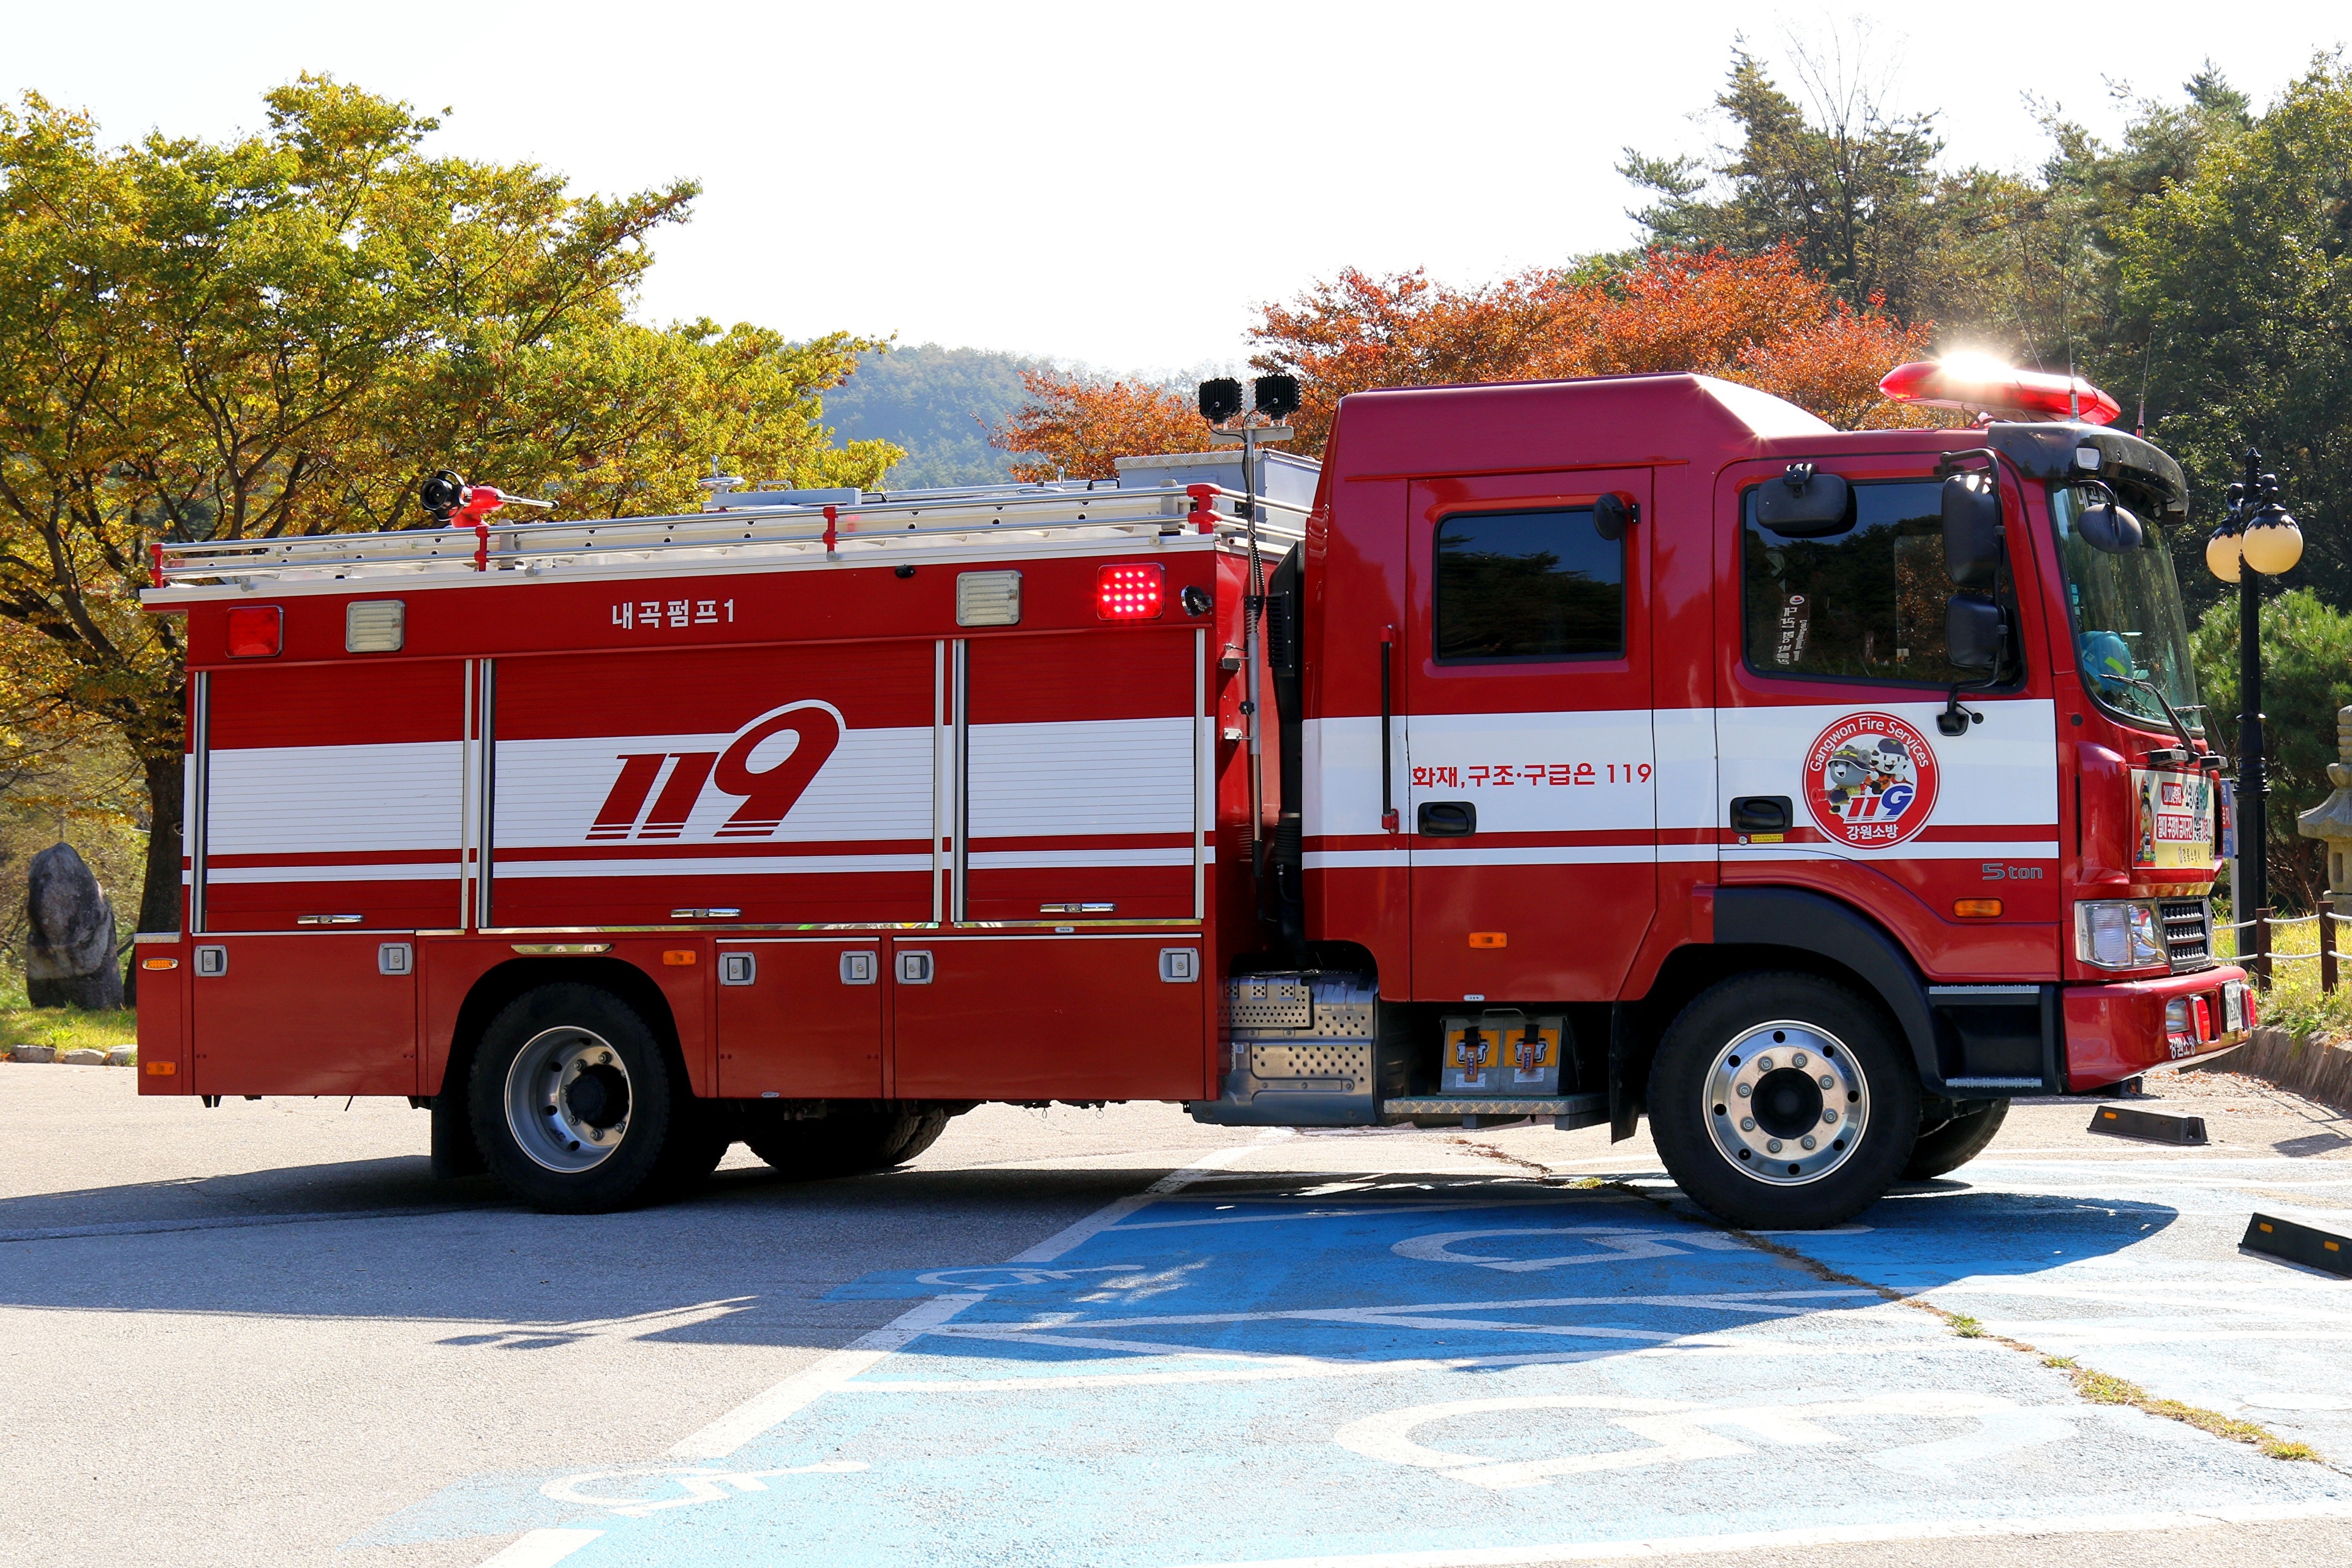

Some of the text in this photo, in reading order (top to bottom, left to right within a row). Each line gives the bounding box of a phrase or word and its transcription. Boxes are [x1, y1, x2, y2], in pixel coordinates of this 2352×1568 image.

[612, 598, 734, 630] 내곡펌프1
[1810, 717, 1929, 772] Gangwon Fire Services
[585, 707, 840, 840] 119
[1606, 763, 1653, 784] 119
[1846, 824, 1899, 840] 강원소방
[2168, 1035, 2196, 1060] 강원소방
